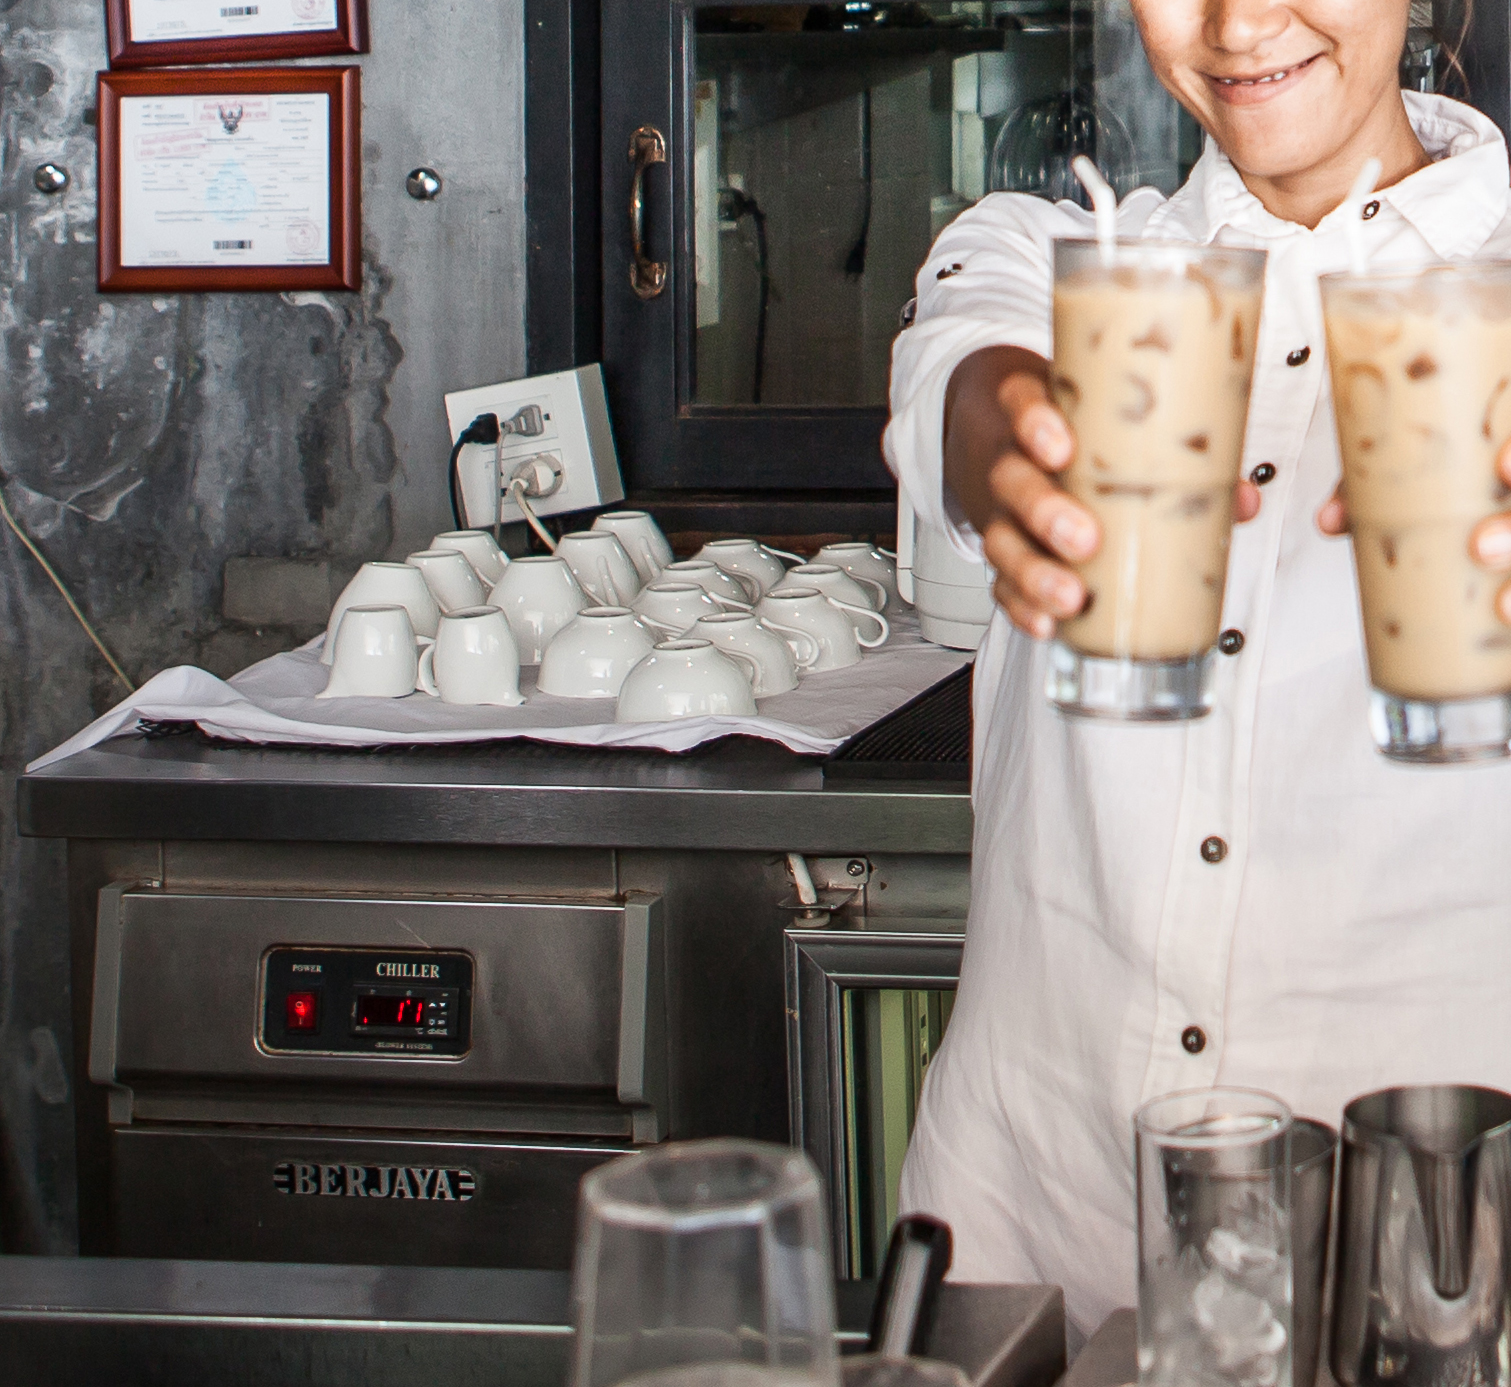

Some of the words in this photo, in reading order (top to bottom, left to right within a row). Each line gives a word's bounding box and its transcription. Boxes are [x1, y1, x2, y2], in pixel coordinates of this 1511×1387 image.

[292, 964, 323, 974] POWER
[375, 961, 441, 979] CHILLER
[292, 1163, 457, 1202] BERJAYA
